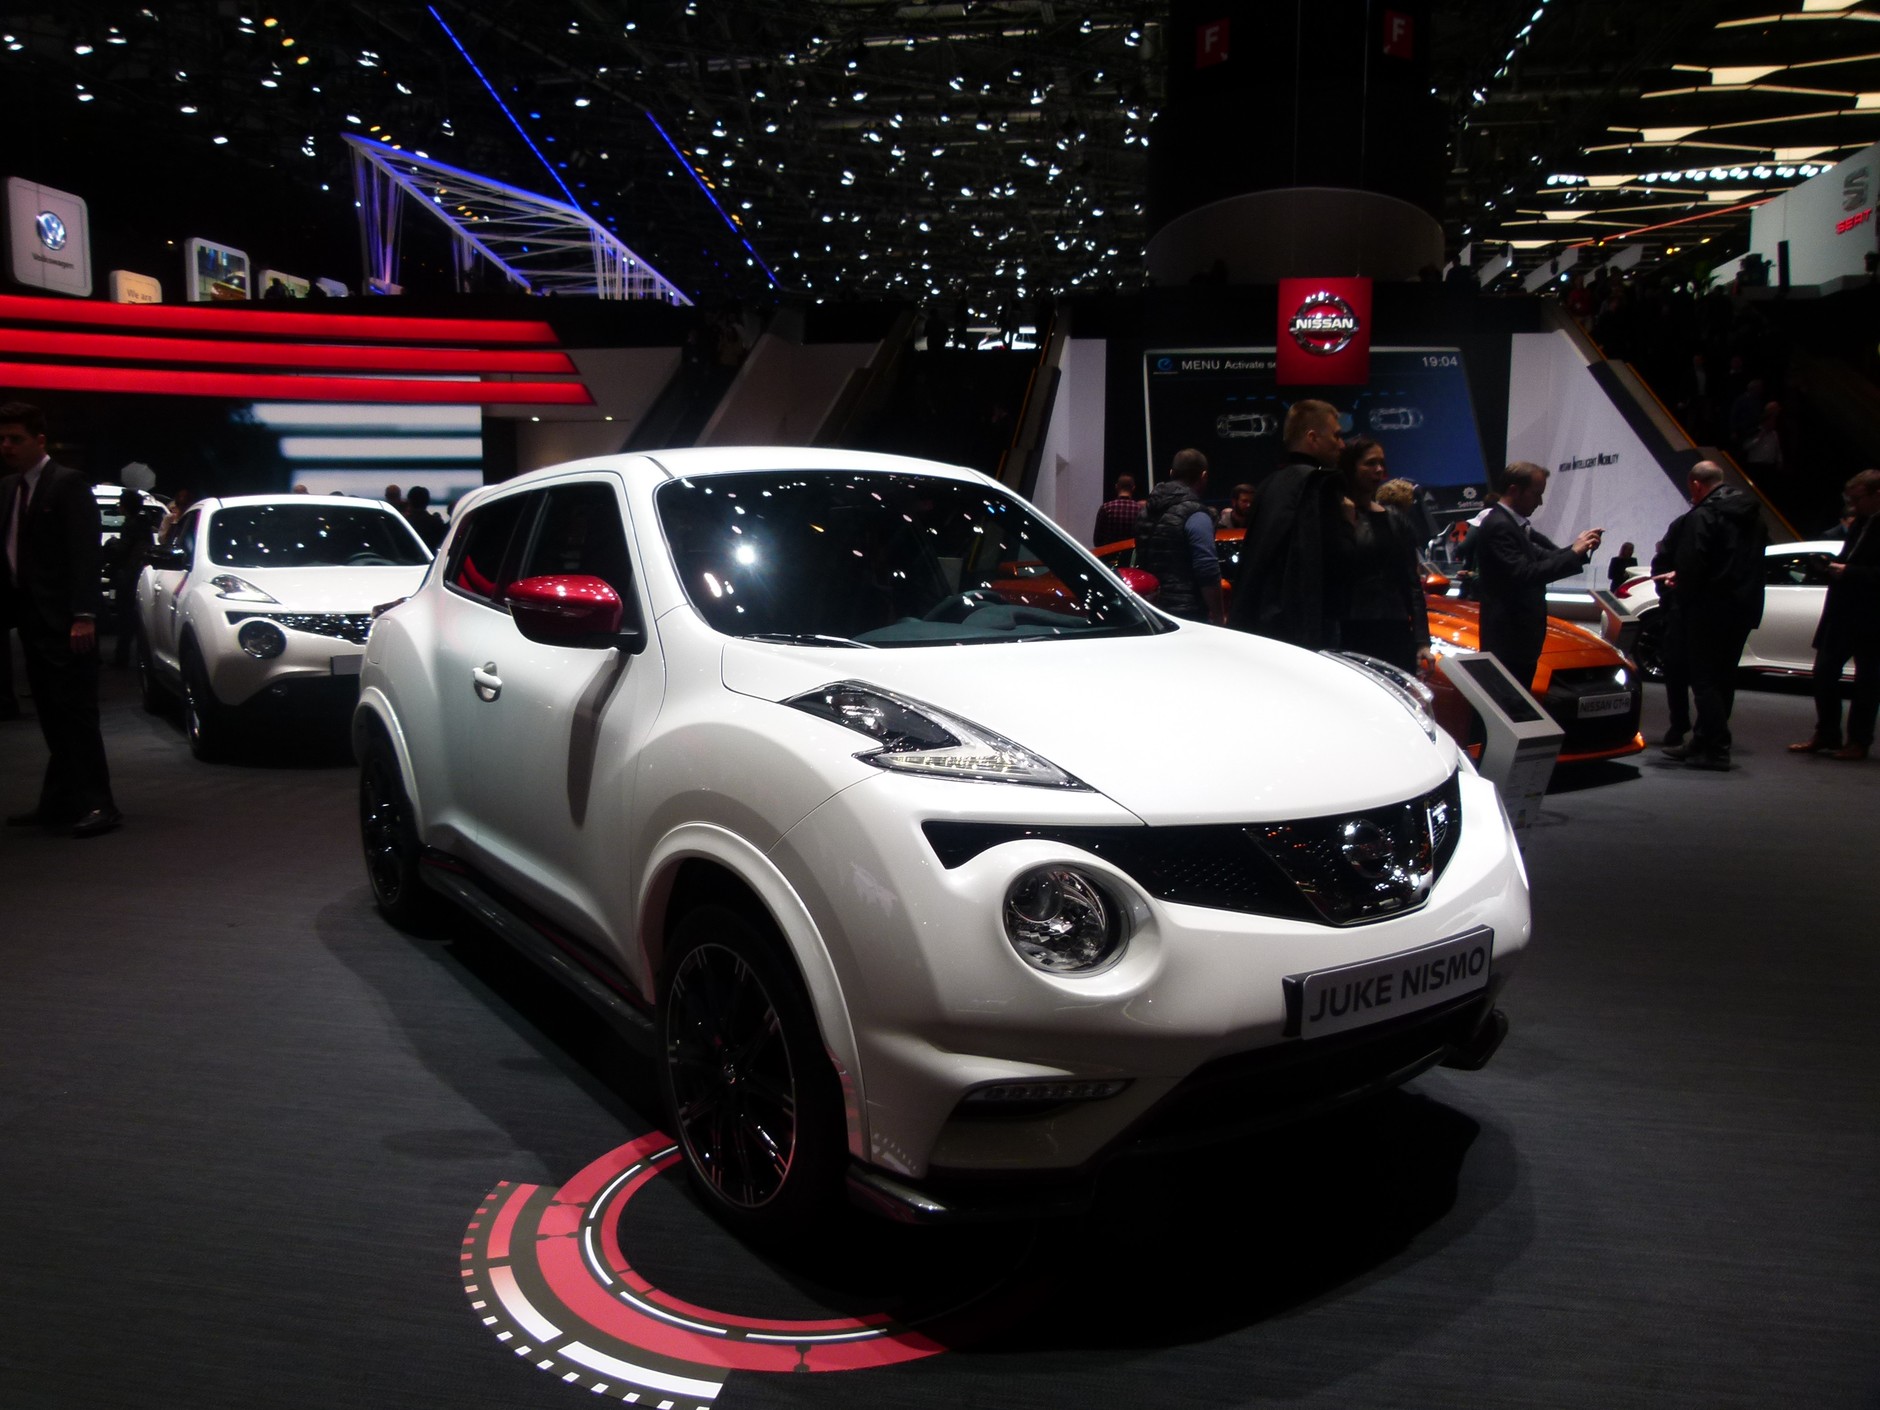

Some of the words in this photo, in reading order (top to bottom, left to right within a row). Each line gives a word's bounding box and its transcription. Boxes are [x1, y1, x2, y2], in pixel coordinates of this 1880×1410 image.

[1204, 24, 1220, 54] F
[1392, 16, 1406, 43] F
[1295, 318, 1354, 329] NISSAN
[1181, 360, 1220, 370] MENU
[1224, 359, 1265, 369] Activate
[1422, 356, 1458, 367] 19:04
[1310, 974, 1393, 1022] JUKE
[1401, 947, 1485, 999] NISMO
